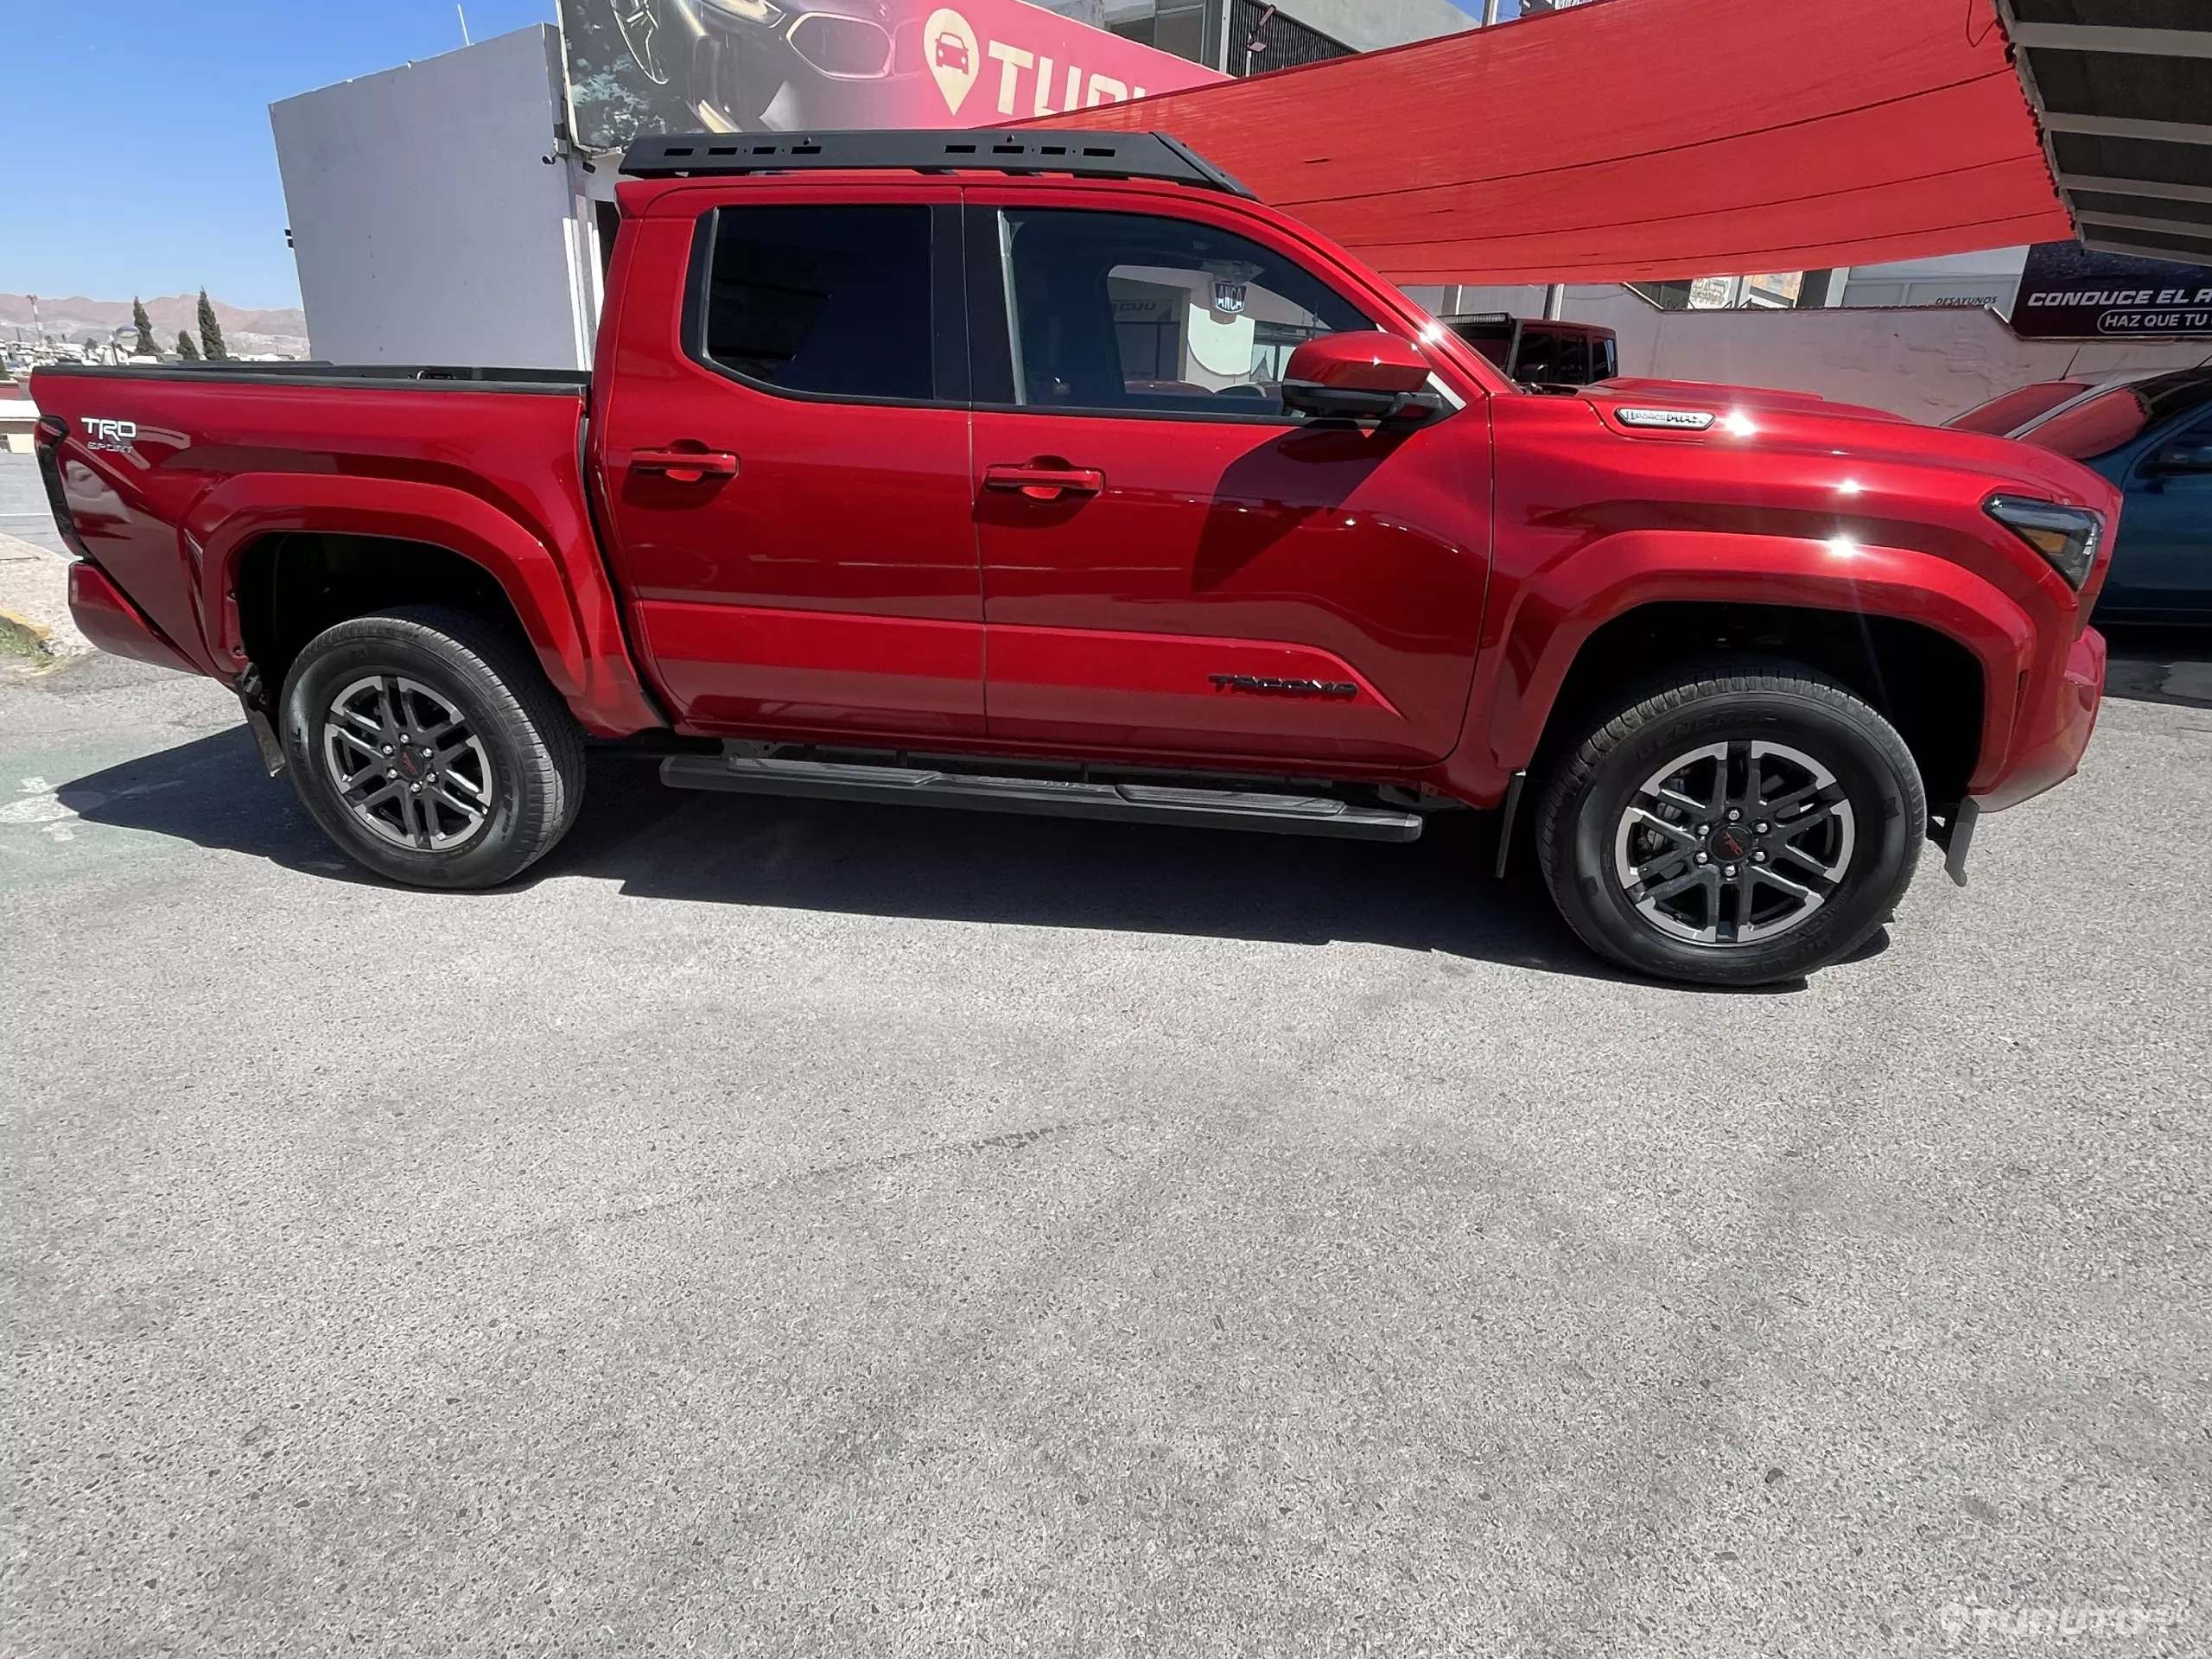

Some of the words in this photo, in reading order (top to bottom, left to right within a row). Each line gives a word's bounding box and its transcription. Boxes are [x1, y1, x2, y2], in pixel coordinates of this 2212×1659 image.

[1936, 296, 1998, 305] DESAYUNOS
[2028, 290, 2154, 306] CONDUCE
[2156, 289, 2190, 303] EL
[2105, 315, 2142, 327] HAZ
[2144, 314, 2180, 327] QUE
[2184, 314, 2209, 326] TU
[80, 417, 137, 442] TRD
[87, 442, 135, 454] SPORT
